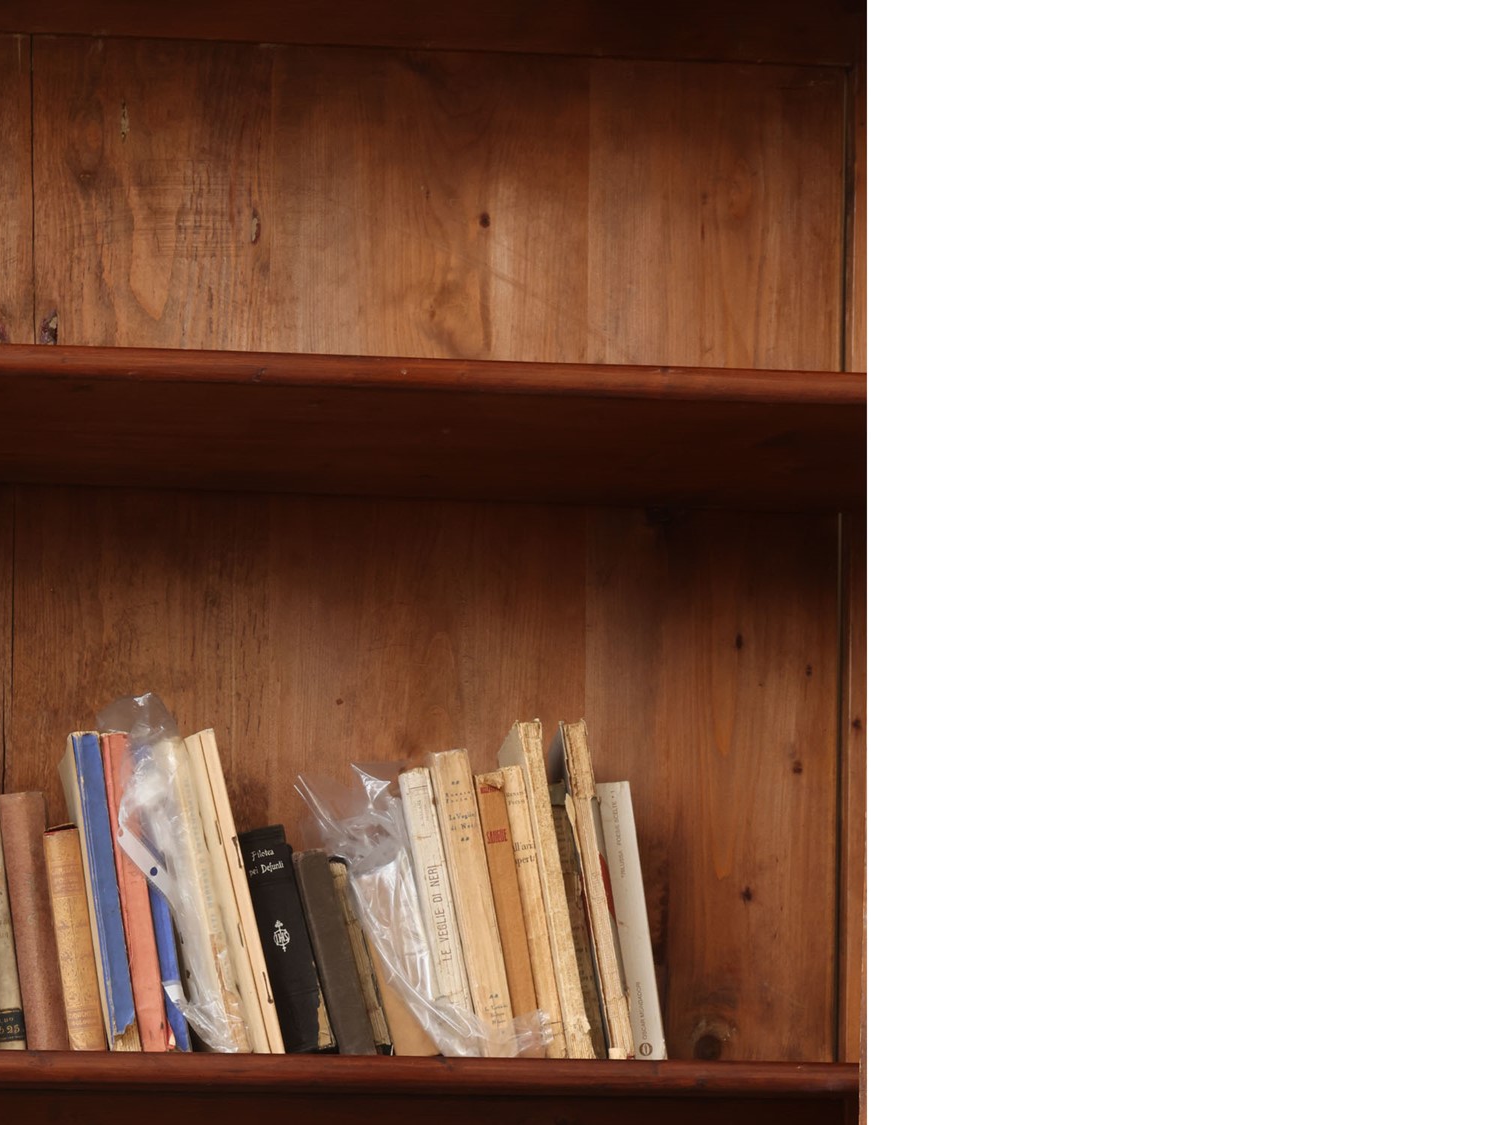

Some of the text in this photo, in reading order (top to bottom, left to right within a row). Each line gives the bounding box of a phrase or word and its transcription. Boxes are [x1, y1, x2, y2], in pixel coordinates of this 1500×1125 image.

[250, 849, 275, 862] Filotea
[427, 864, 453, 962] LE VEGLIE DI NERI
[636, 981, 648, 1041] OSCAR MONDADORI
